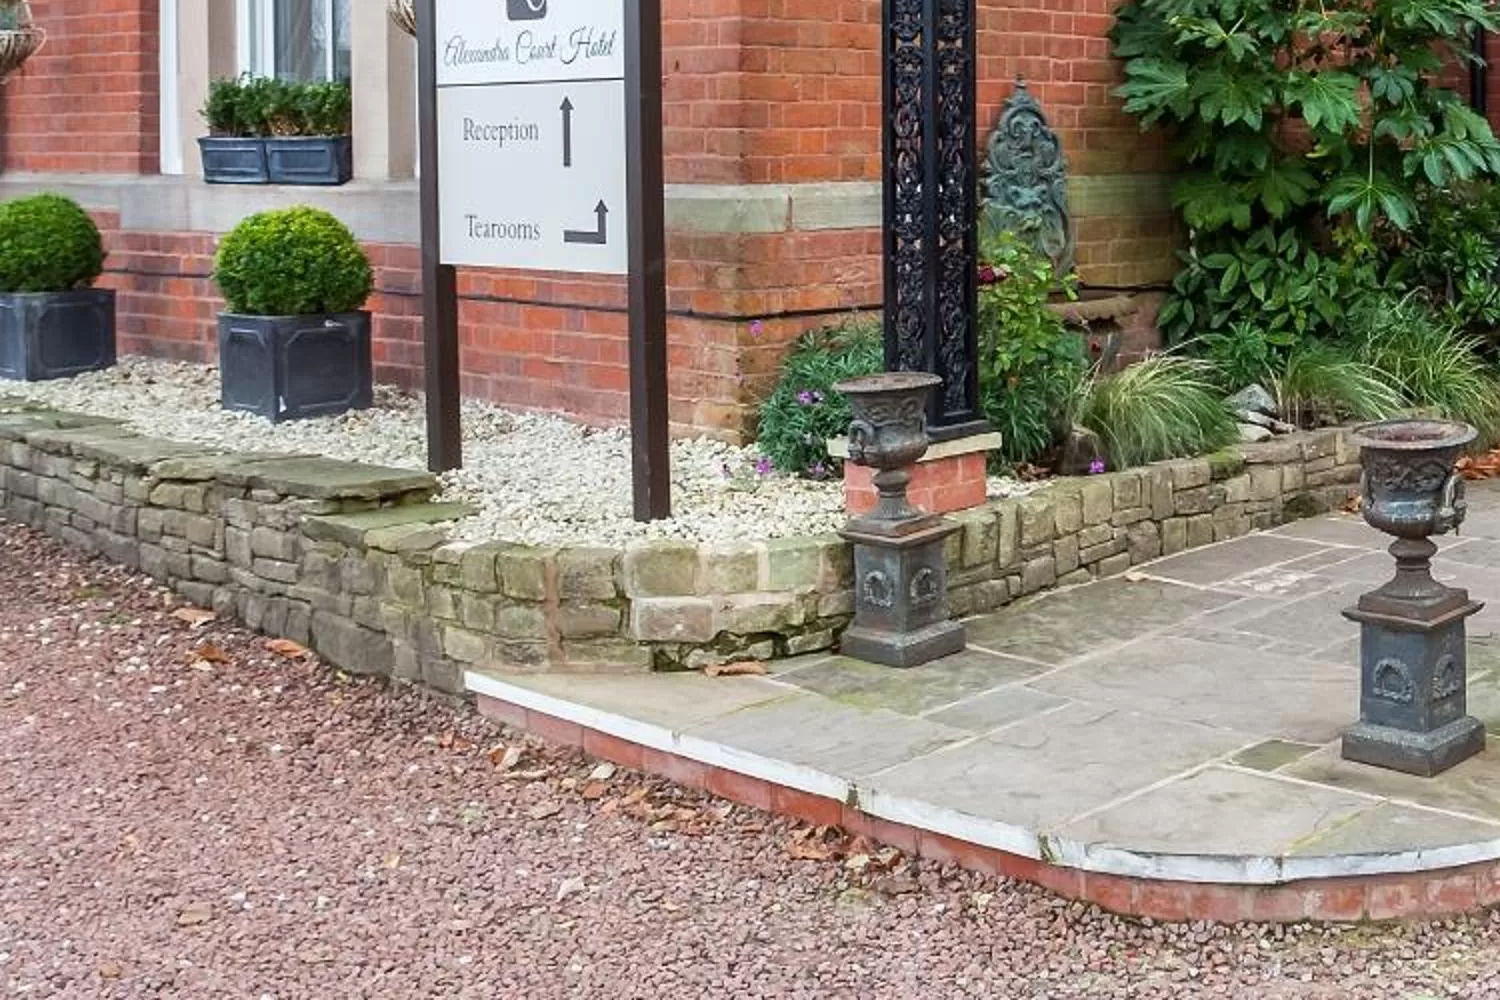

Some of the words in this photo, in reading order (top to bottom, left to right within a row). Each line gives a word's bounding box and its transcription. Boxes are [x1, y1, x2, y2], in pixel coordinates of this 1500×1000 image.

[515, 29, 557, 65] Court
[560, 25, 617, 65] Hotel
[463, 116, 539, 149] Reception
[463, 213, 541, 241] Tearooms
